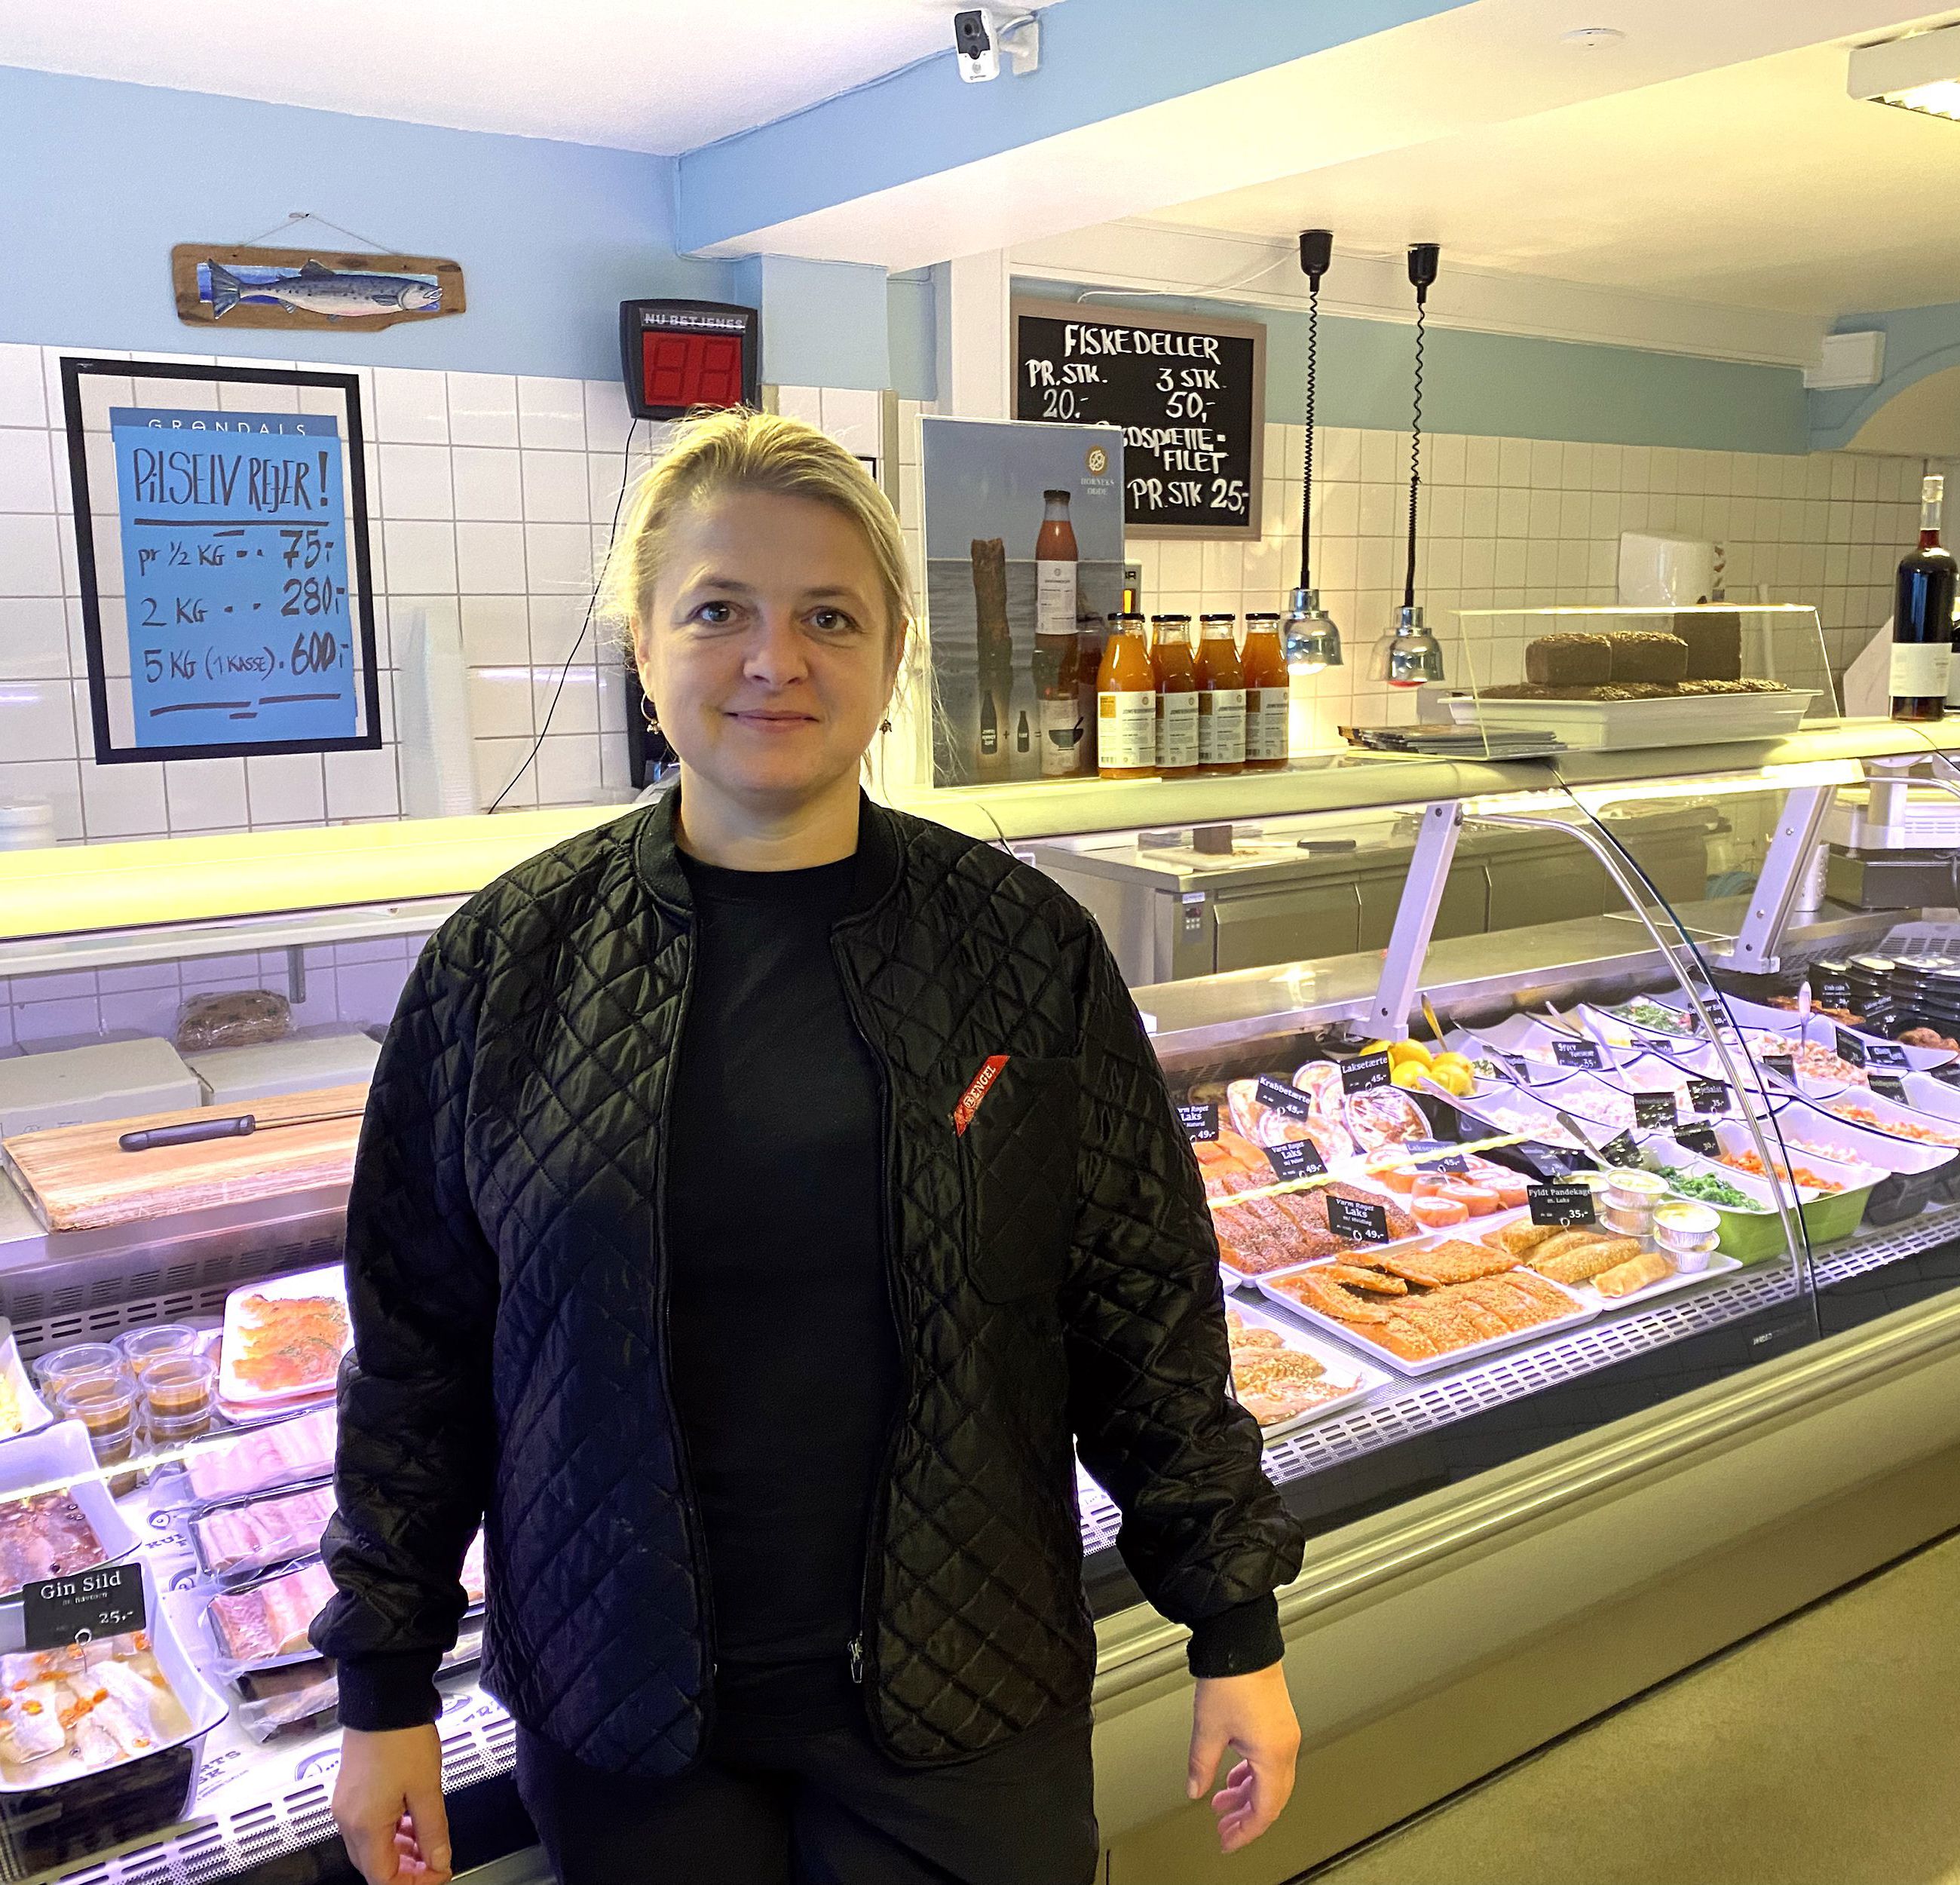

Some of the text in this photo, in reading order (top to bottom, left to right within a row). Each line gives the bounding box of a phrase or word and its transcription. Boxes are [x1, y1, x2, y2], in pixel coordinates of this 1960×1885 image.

[1156, 368, 1173, 391] 3
[1164, 450, 1229, 474] FILET
[138, 548, 161, 576] pr
[198, 544, 225, 566] KG
[141, 597, 167, 627] 2
[176, 597, 208, 624] KG
[143, 649, 162, 682] 5
[170, 650, 196, 679] KG
[1342, 1056, 1388, 1074] Laksetærte
[970, 1065, 996, 1099] ENGEL
[1260, 1077, 1311, 1104] Krabbetærte
[1181, 1113, 1202, 1121] Laks
[1282, 1150, 1303, 1160] Laks
[1528, 1189, 1548, 1197] Fyldt
[1345, 1206, 1368, 1218] Laks
[41, 1570, 121, 1600] Gin Sild
